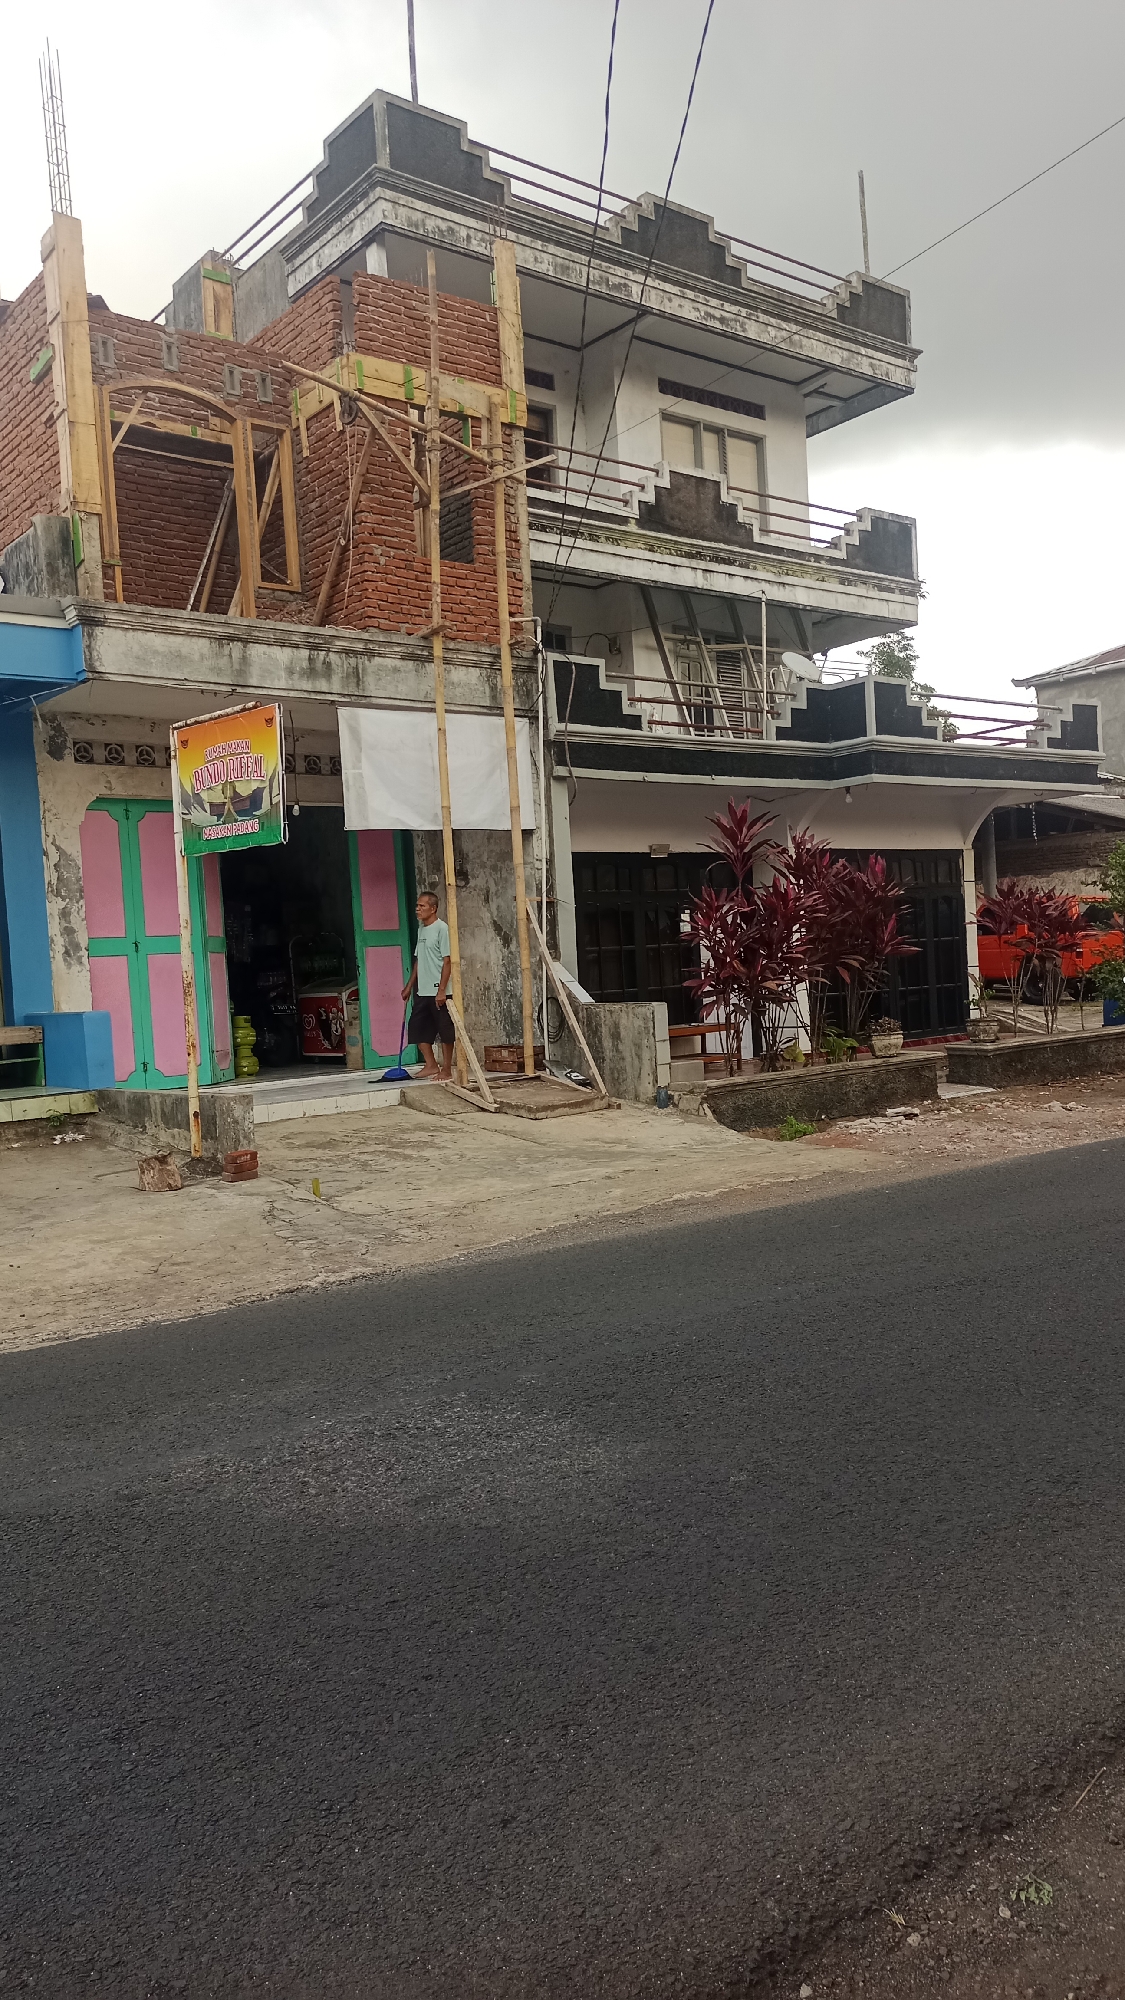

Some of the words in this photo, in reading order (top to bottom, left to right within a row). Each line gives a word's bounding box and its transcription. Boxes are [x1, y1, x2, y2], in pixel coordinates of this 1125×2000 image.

[205, 743, 227, 760] RUMAH
[227, 739, 250, 753] MAKAN
[193, 759, 226, 793] BUNDO
[228, 754, 265, 781] RIFFAL
[203, 824, 232, 840] MASAKAN
[232, 819, 259, 835] PADANG
